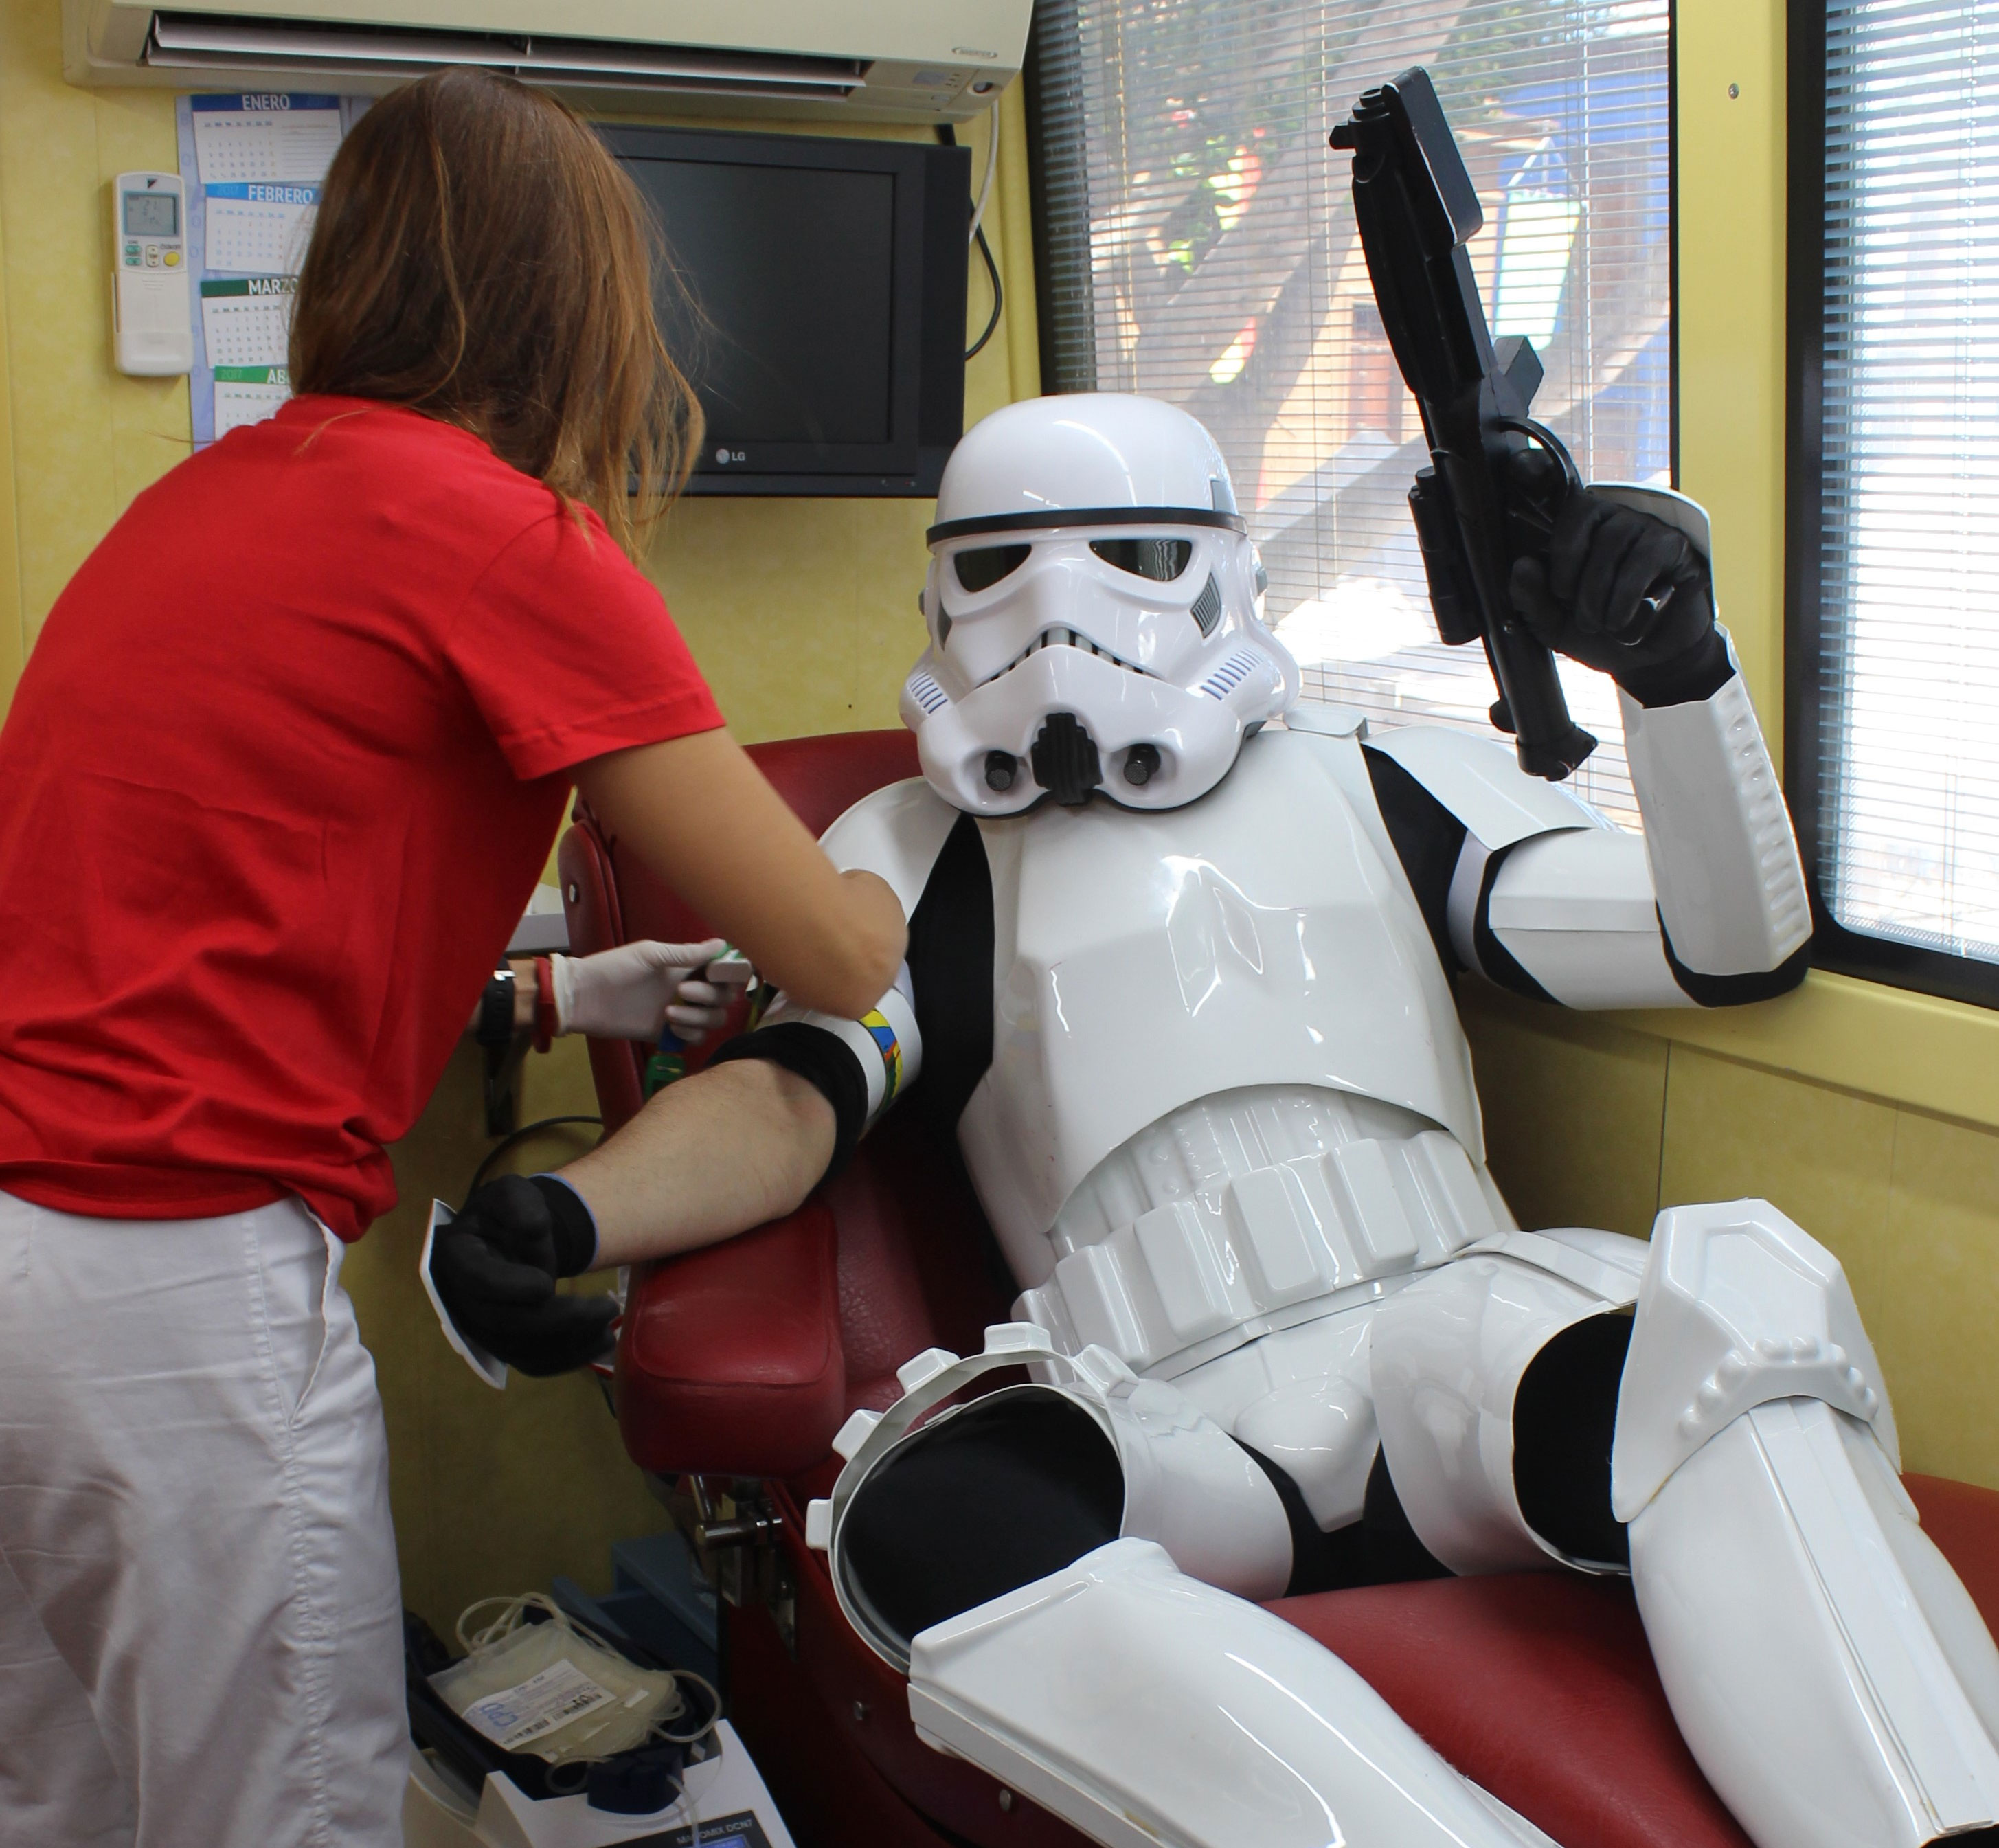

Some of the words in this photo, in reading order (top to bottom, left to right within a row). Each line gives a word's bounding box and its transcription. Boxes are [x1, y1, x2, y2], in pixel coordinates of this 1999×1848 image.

[242, 94, 291, 111] ENERO
[248, 184, 313, 204] FEBRERO
[267, 368, 289, 385] AB
[732, 451, 745, 462] LG
